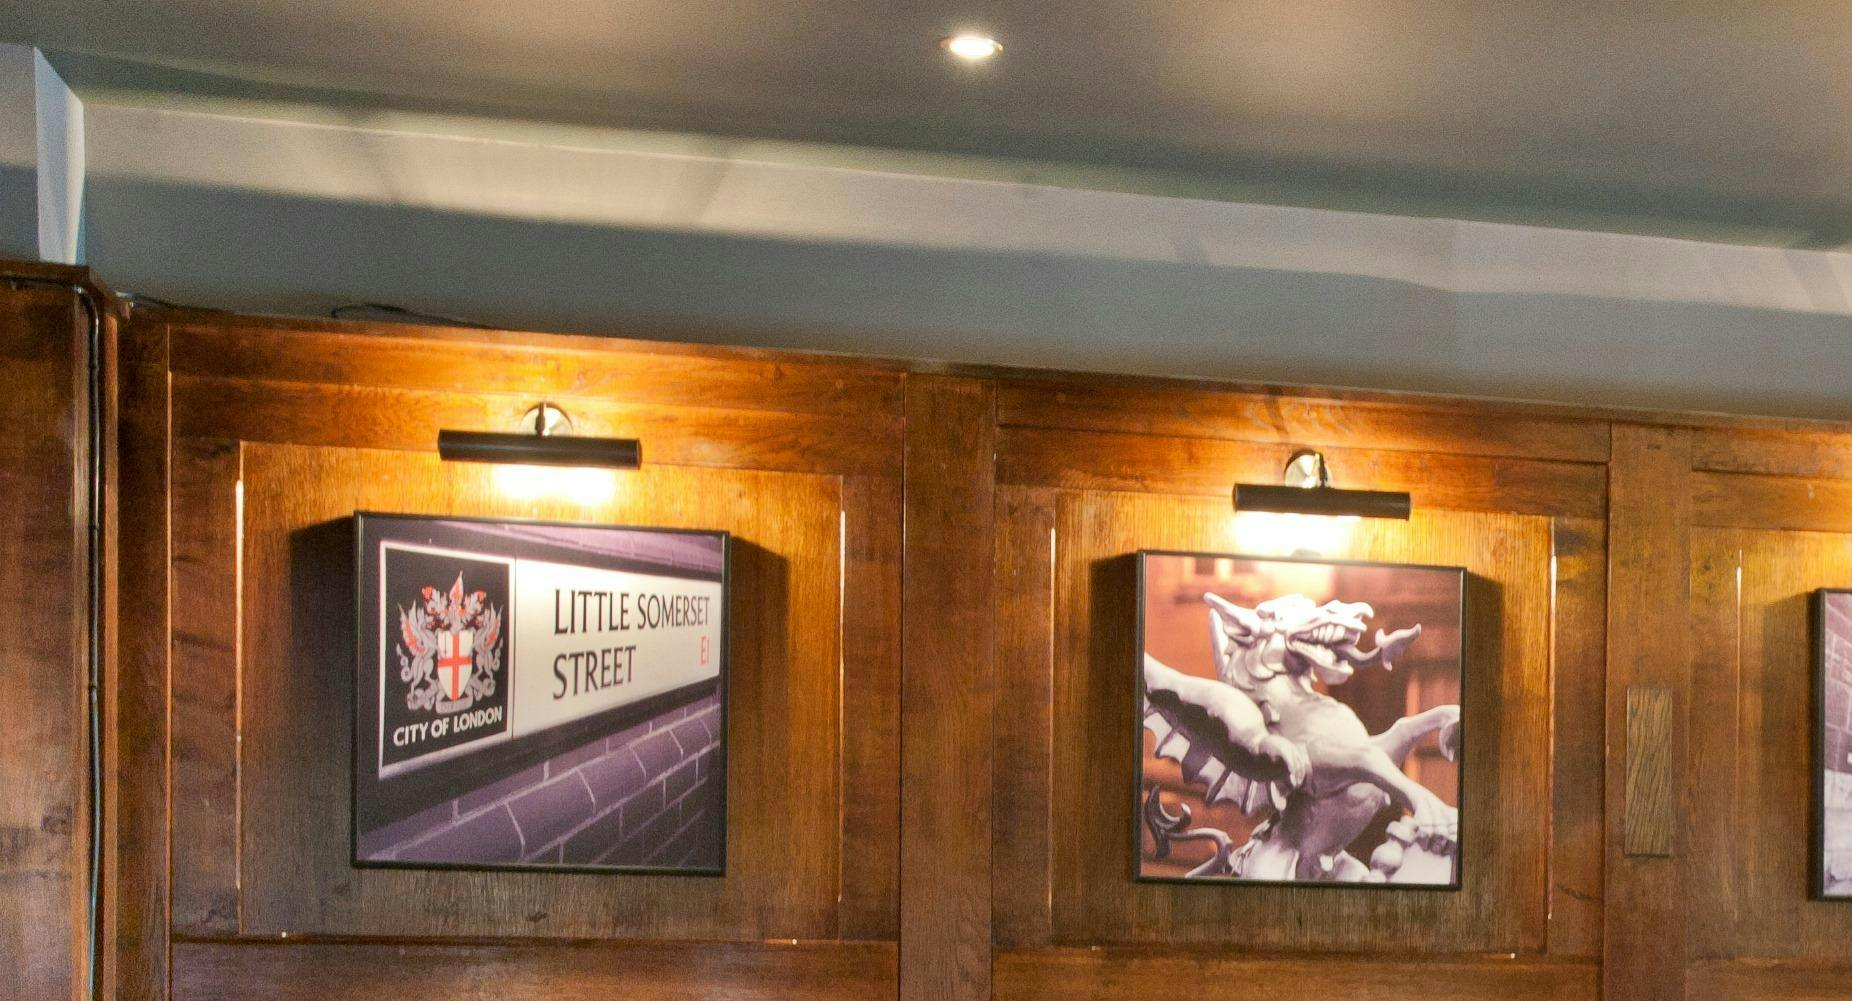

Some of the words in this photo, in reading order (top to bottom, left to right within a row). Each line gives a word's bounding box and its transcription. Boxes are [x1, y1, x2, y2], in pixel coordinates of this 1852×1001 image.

[553, 588, 631, 635] LITTLE
[636, 594, 711, 630] SOMERSET
[552, 644, 637, 700] STREET
[393, 720, 429, 747] CITY
[431, 716, 449, 738] OF
[453, 705, 503, 734] LONDON
